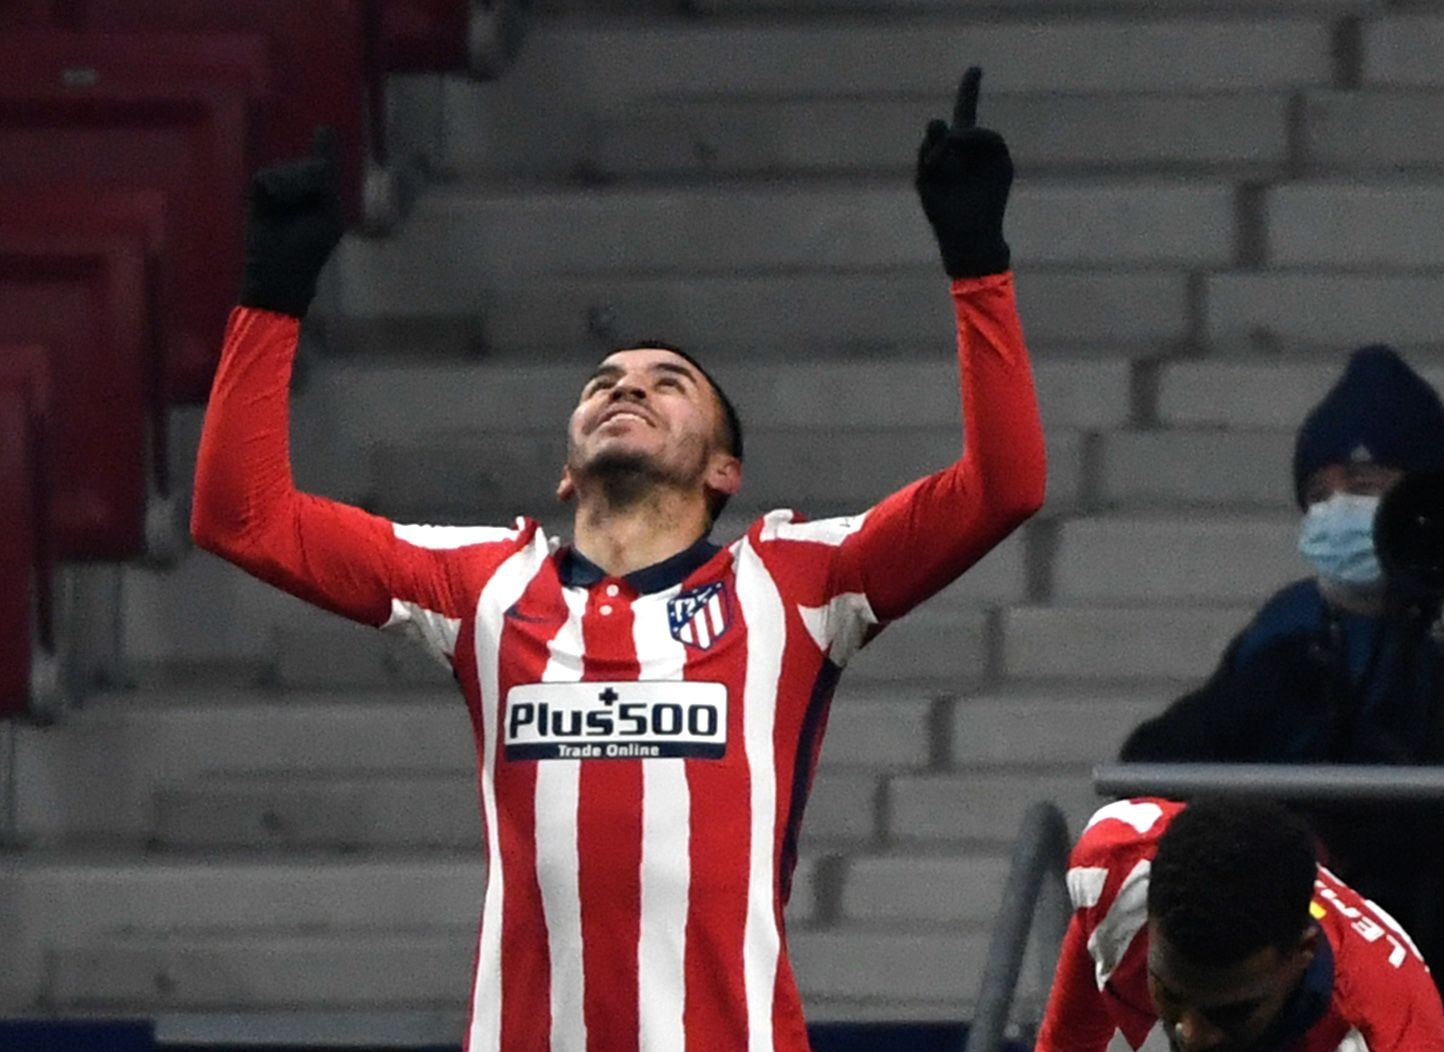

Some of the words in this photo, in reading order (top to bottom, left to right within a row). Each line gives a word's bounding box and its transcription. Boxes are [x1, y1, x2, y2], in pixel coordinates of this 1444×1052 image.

[509, 702, 718, 739] Plus500
[558, 744, 602, 757] Trade
[606, 743, 660, 757] Online
